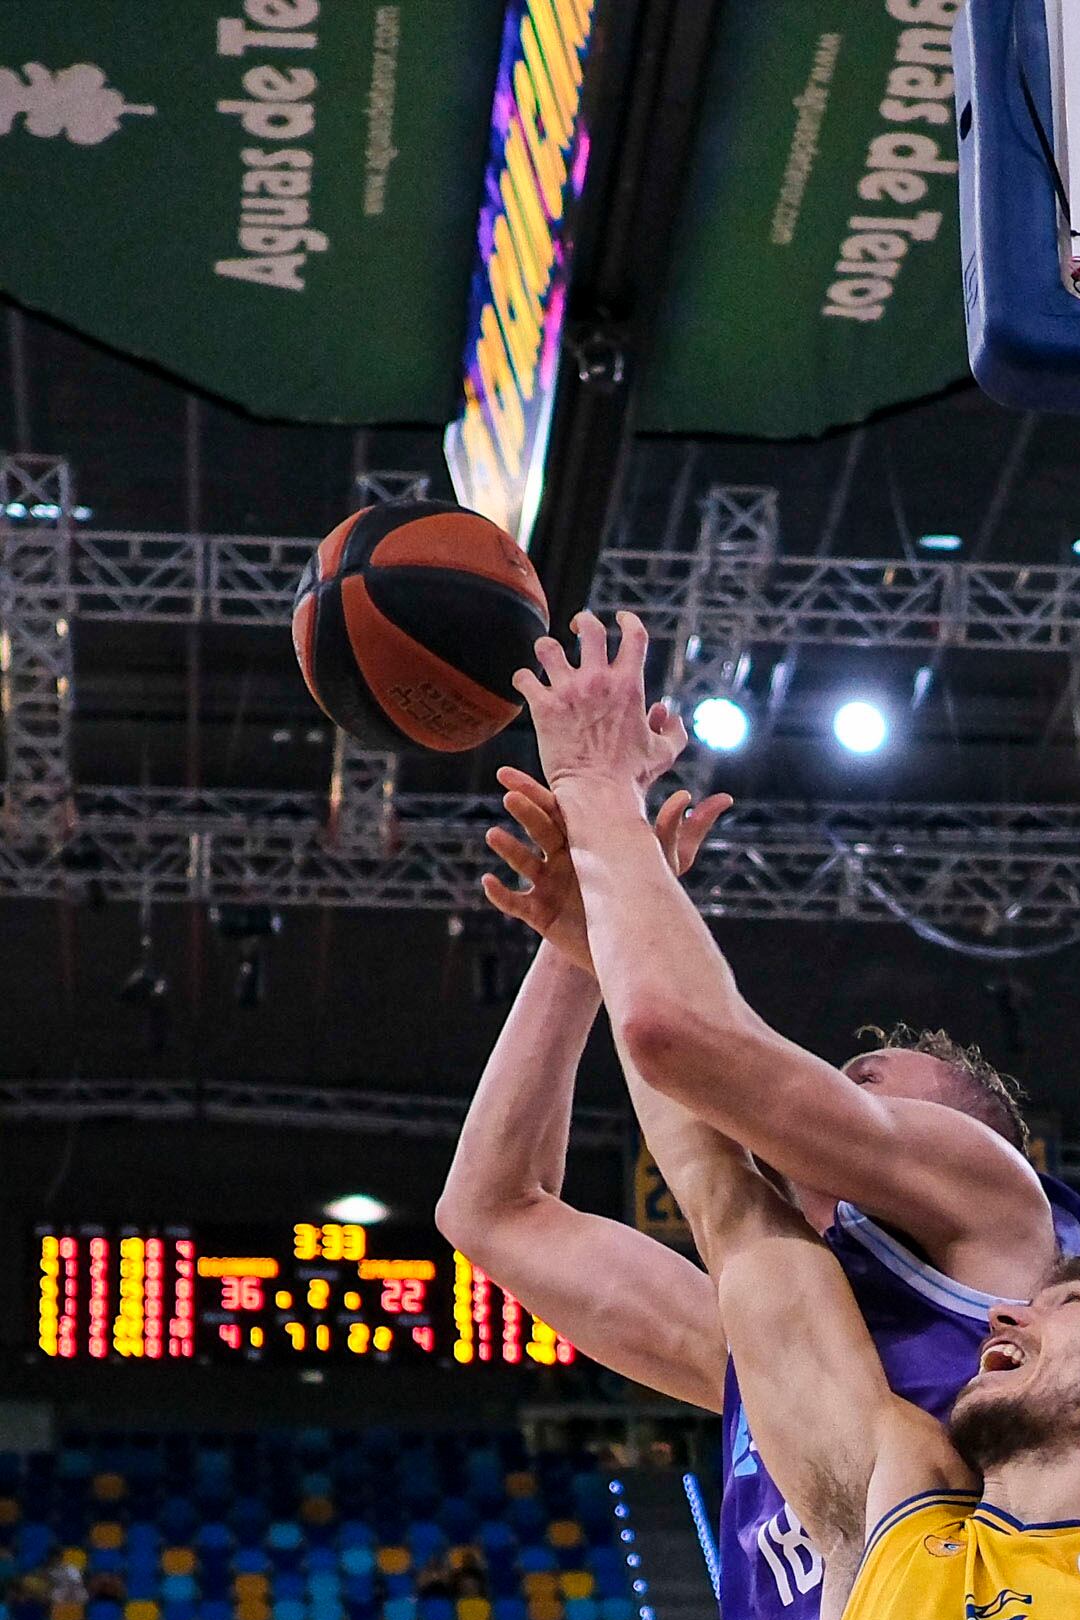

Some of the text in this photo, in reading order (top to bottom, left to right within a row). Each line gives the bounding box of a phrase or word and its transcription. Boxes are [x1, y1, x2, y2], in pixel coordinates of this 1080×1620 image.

[216, 65, 317, 139] de
[856, 133, 960, 203] de
[214, 148, 329, 291] Aguas
[822, 211, 943, 321] Teror
[293, 1223, 366, 1261] 3:33
[221, 1277, 264, 1311] 36
[381, 1279, 427, 1314] 22
